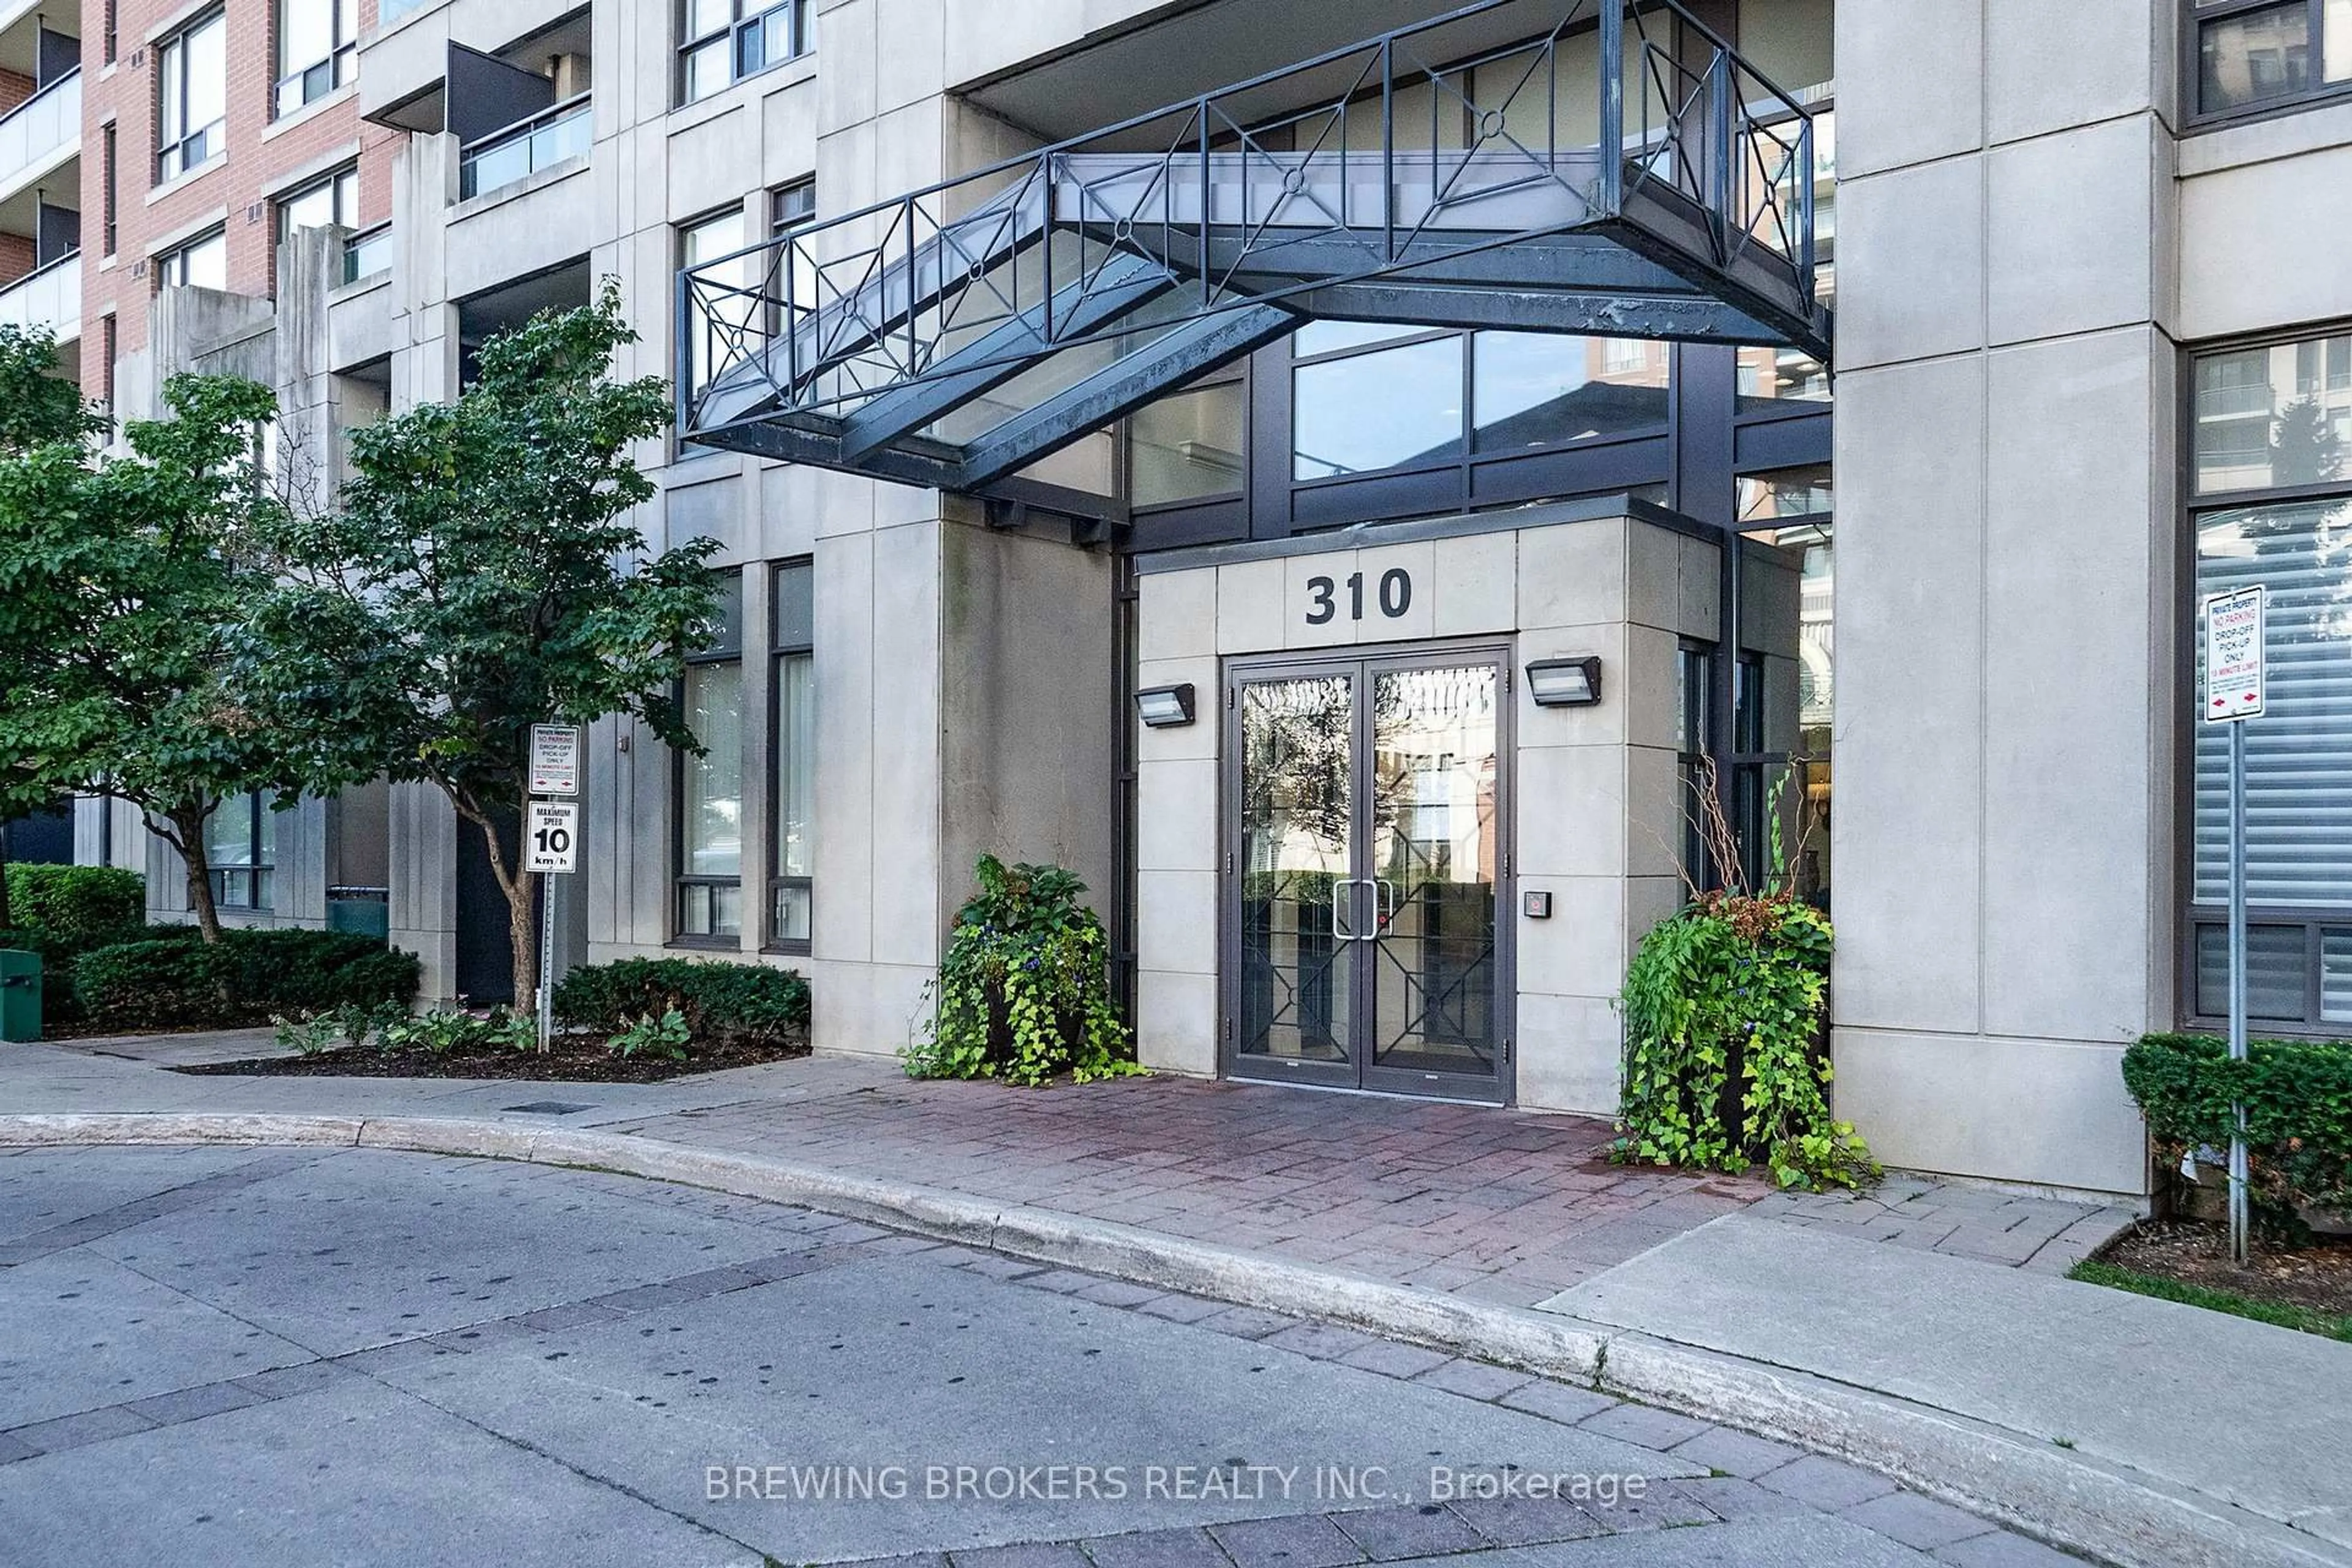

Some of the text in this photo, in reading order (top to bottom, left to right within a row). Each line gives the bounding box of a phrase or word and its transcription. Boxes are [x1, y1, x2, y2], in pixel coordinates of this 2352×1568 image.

[1306, 568, 1411, 625] 310
[2214, 616, 2223, 626] NO
[2215, 624, 2254, 641] DROP-OFF
[2219, 637, 2250, 651] PICK-UP
[2225, 652, 2244, 663] ONLY
[537, 807, 570, 816] MAXIMUM
[543, 817, 562, 826] SPEED
[535, 828, 570, 853] 10
[535, 856, 567, 866] km/h
